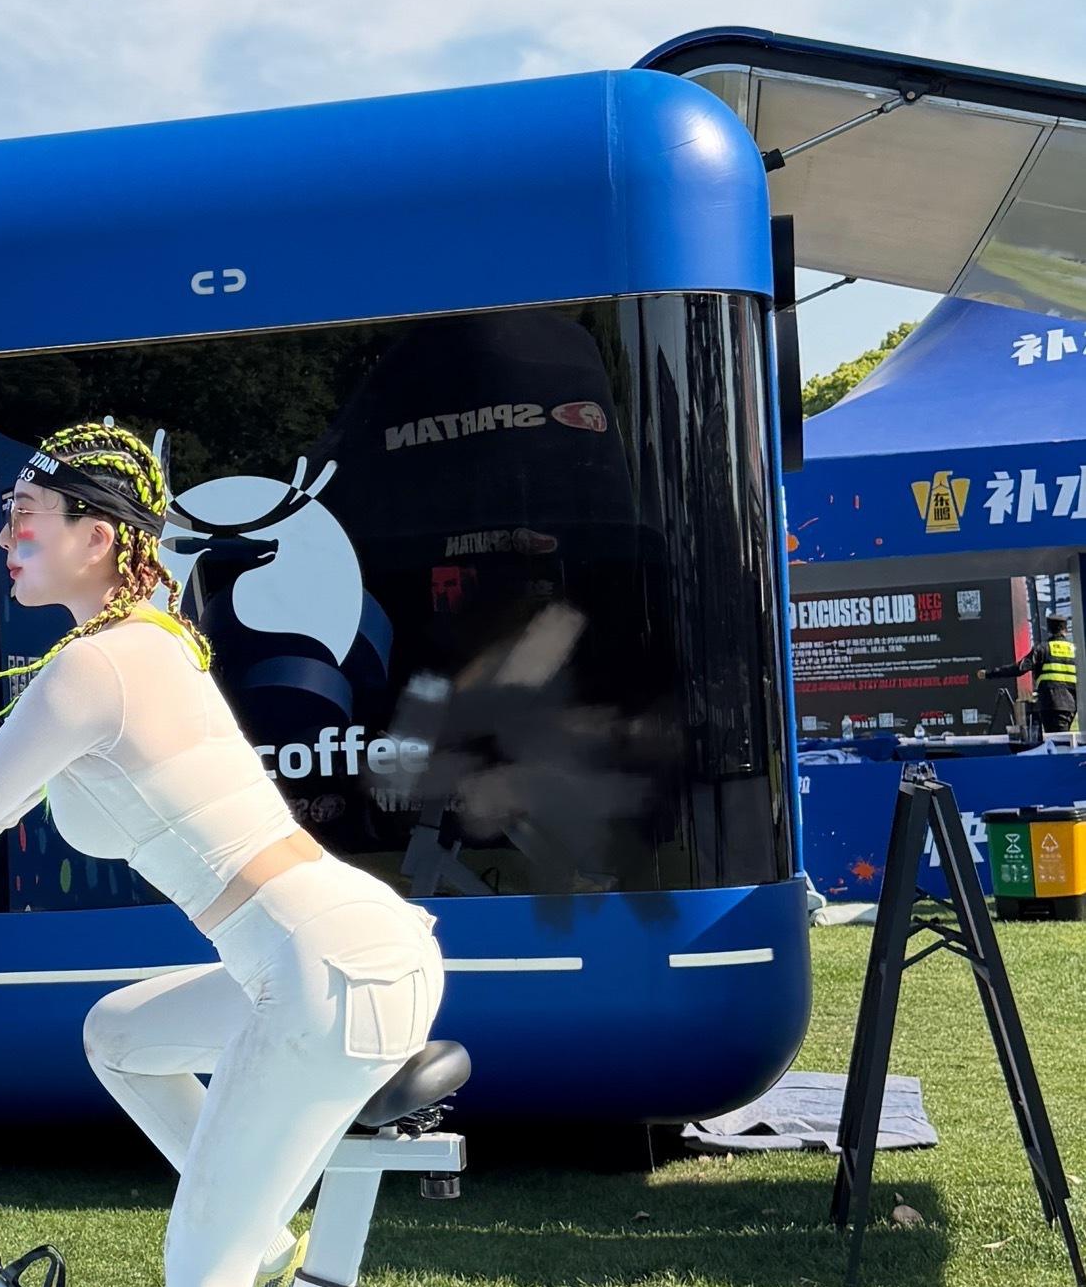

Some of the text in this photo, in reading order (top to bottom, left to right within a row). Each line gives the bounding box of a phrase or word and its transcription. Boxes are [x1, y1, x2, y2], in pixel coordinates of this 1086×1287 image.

[1011, 328, 1086, 366] 补
[798, 597, 871, 630] EXCUSES
[872, 594, 917, 625] CLUB
[254, 725, 429, 780] coffee
